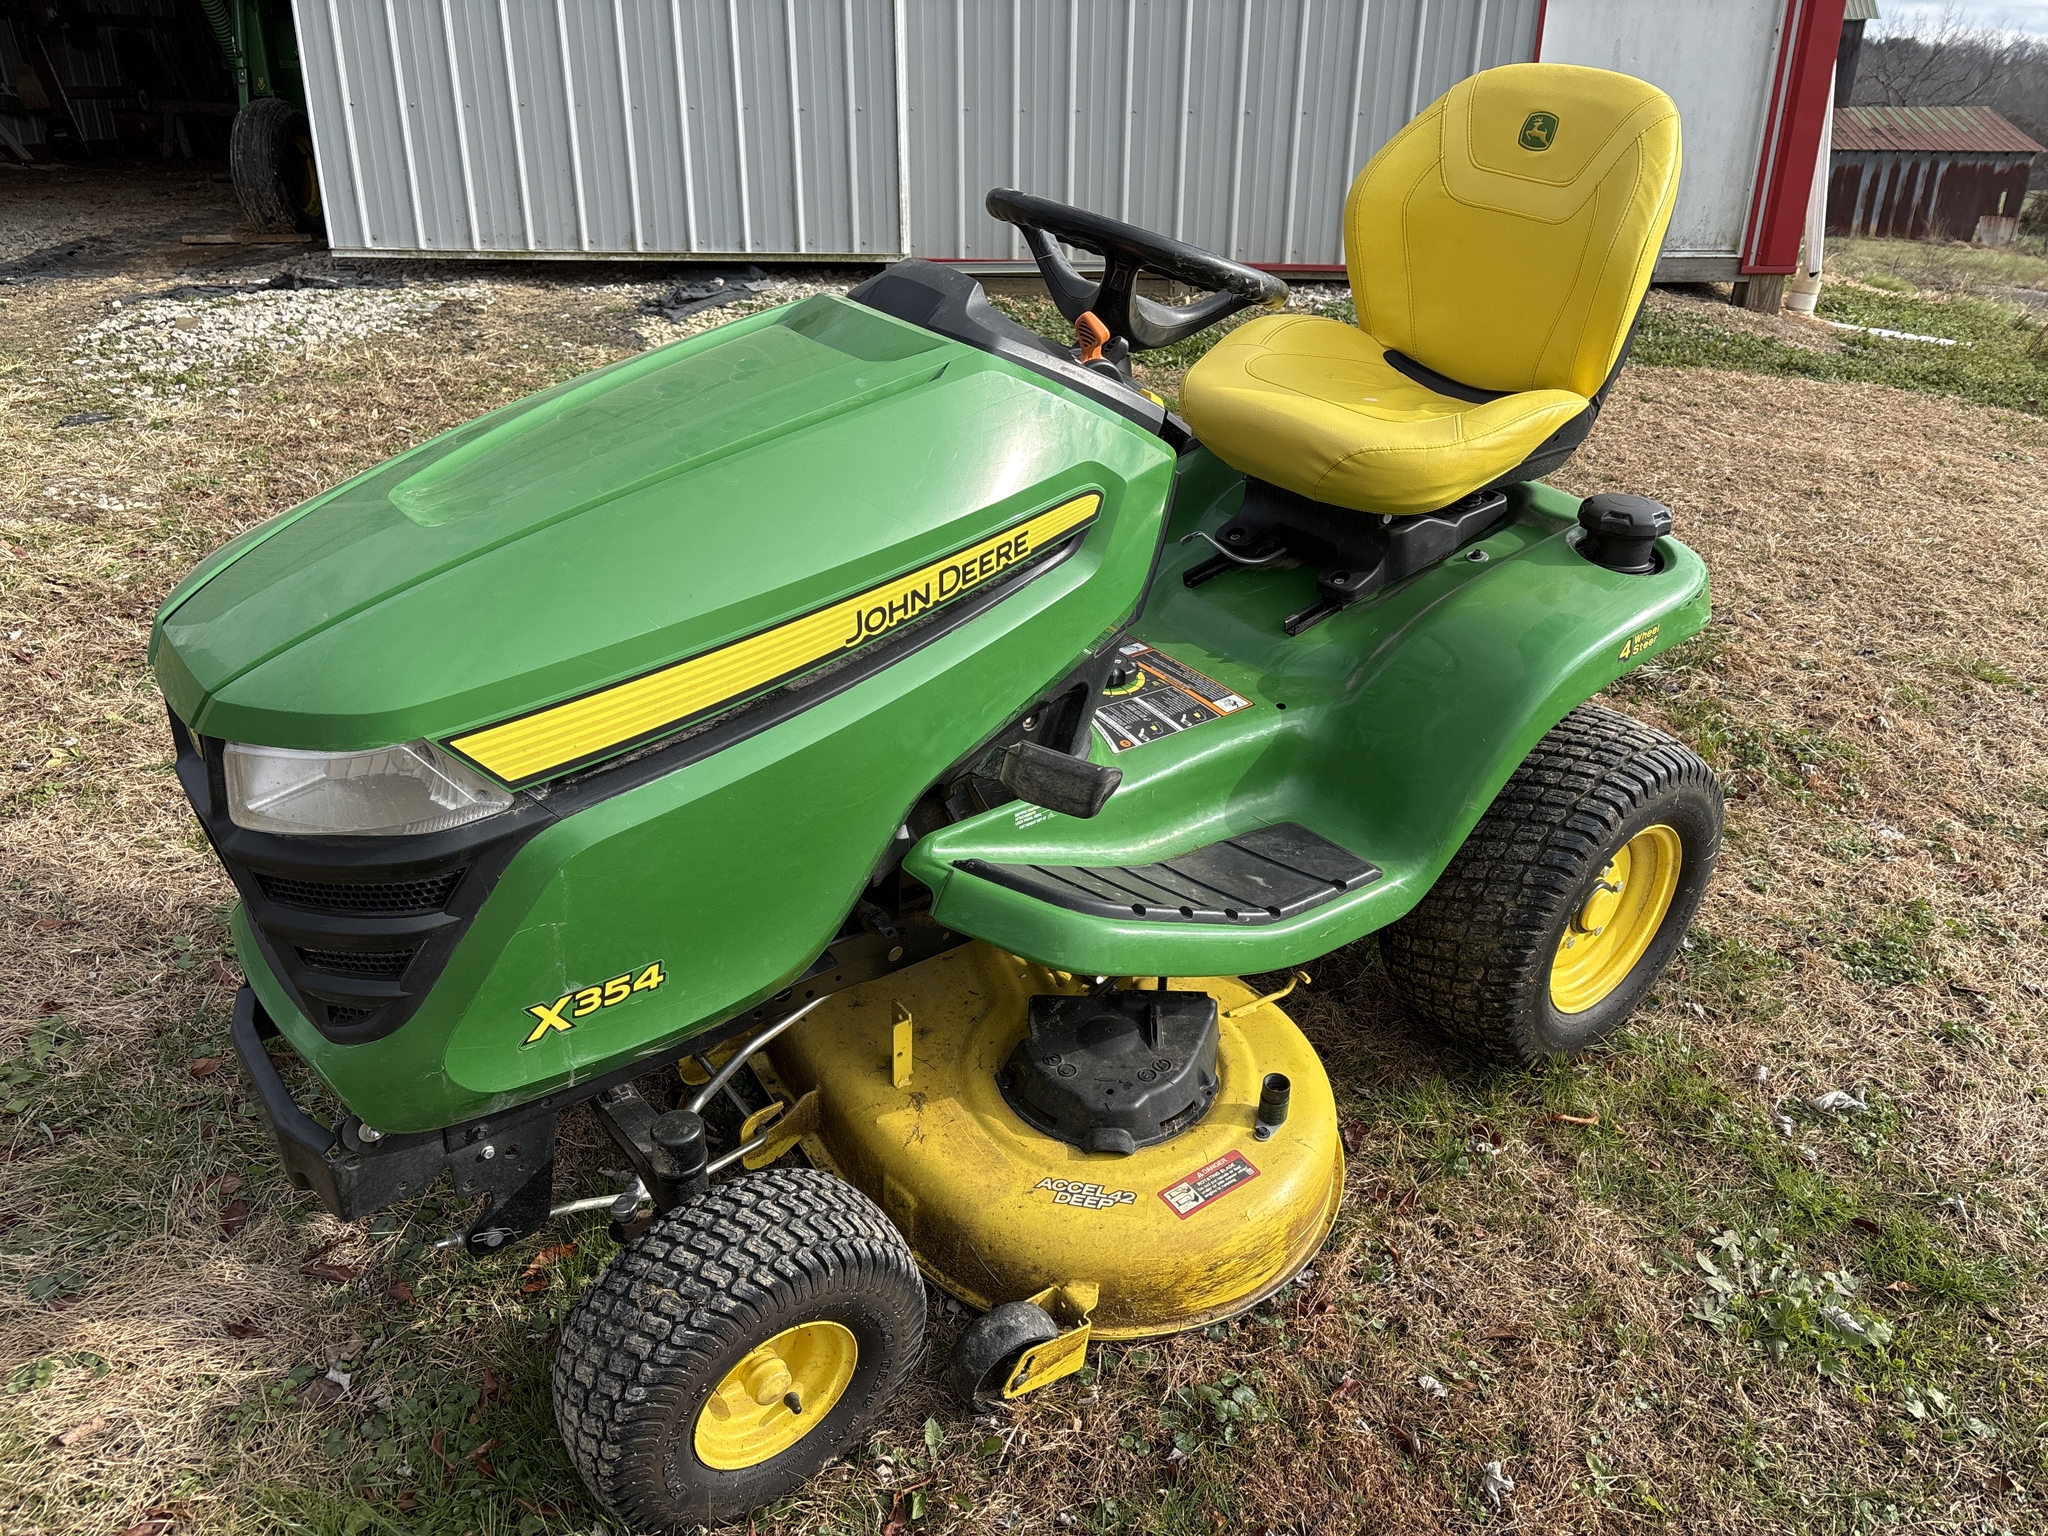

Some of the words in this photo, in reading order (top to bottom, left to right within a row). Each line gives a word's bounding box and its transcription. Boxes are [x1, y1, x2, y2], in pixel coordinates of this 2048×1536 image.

[845, 582, 931, 646] JOHN
[938, 529, 1030, 599] DEERE
[1618, 638, 1632, 661] 4
[1634, 622, 1661, 645] Wheel
[1632, 635, 1658, 655] Steer
[521, 961, 667, 1047] X354
[1196, 1171, 1221, 1187] ROTATING
[1219, 1162, 1236, 1174] BLADE
[1201, 1157, 1228, 1175] DANGER
[1034, 1177, 1109, 1199] ACCEL
[1107, 1190, 1138, 1205] 42
[1052, 1191, 1115, 1210] DEEP
